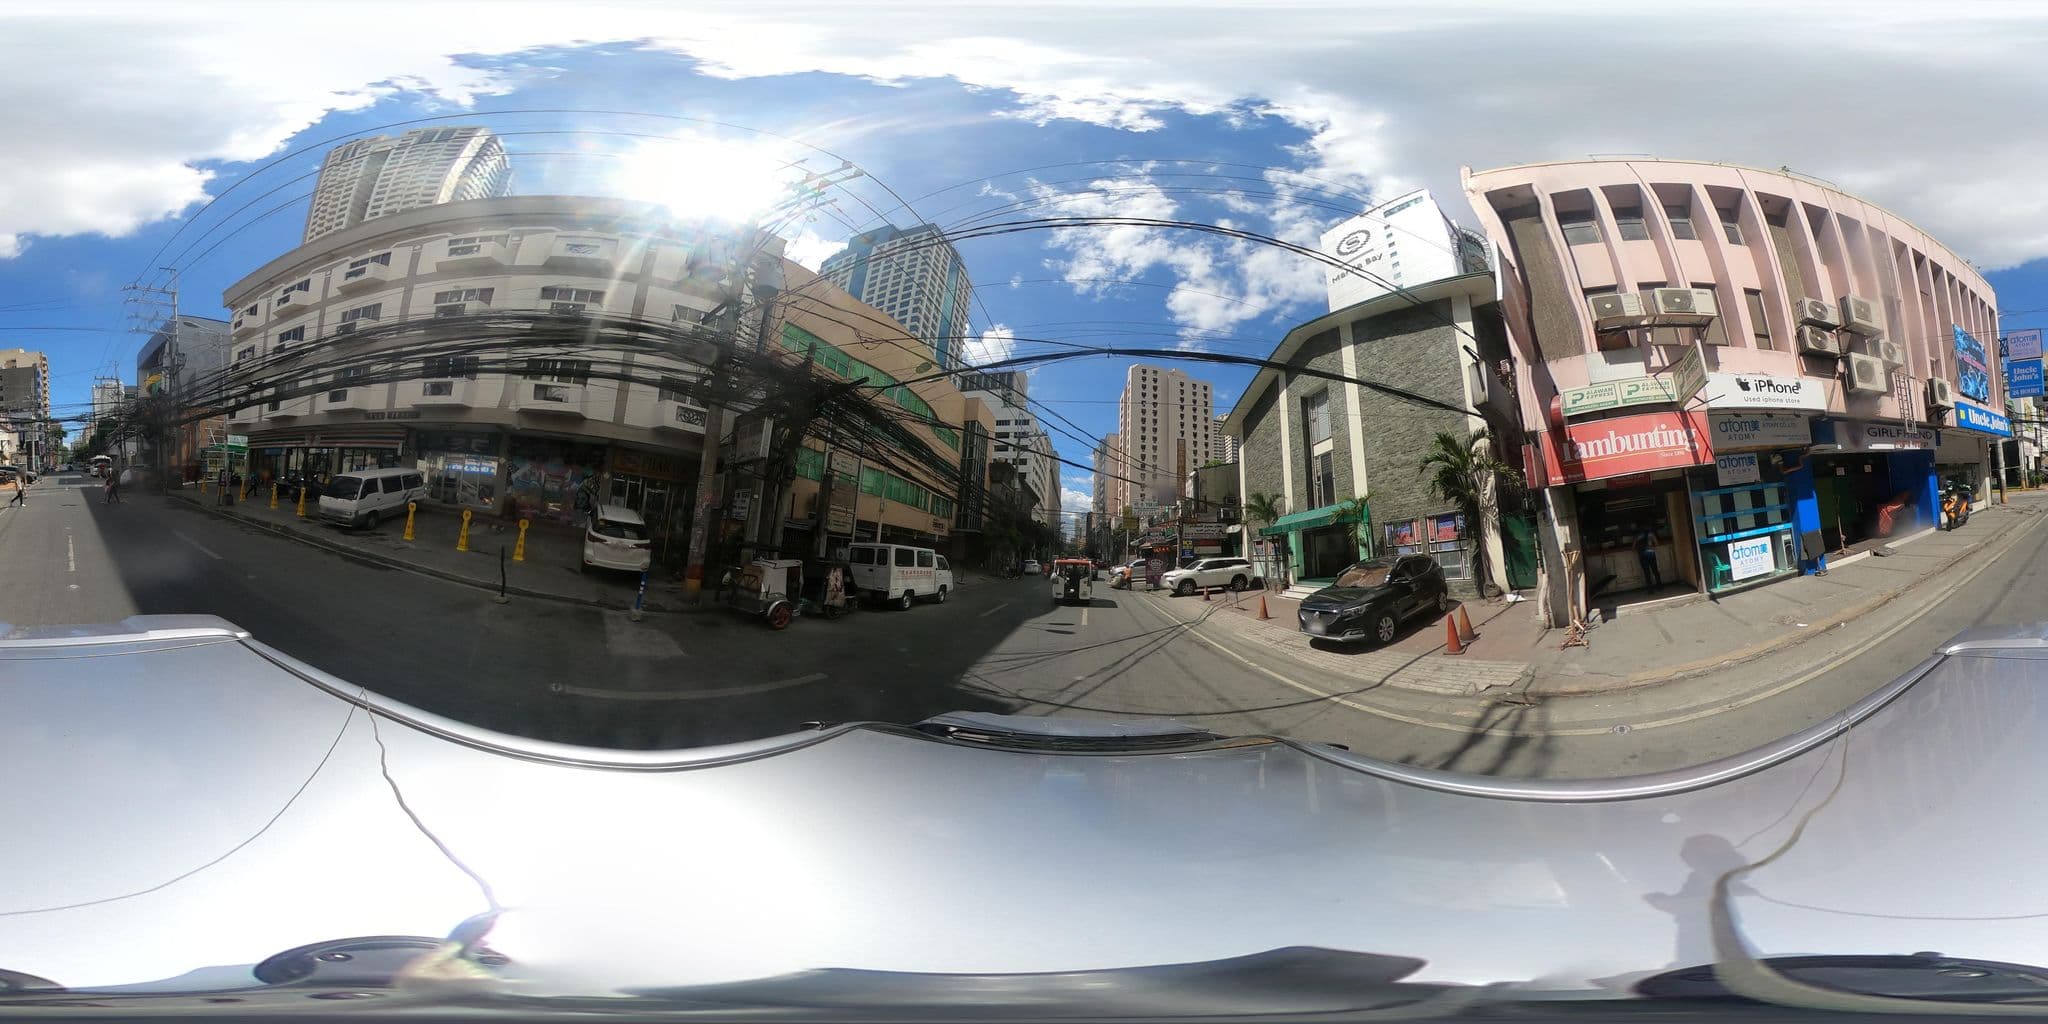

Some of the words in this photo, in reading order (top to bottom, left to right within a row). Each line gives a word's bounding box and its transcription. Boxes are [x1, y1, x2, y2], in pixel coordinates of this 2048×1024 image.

[1332, 263, 1363, 284] Mana
[1365, 252, 1383, 266] Bay
[2011, 371, 2040, 382] John's
[2013, 366, 2037, 376] Uncle
[1754, 379, 1800, 394] iPhone
[1586, 391, 1614, 400] EXPRESS
[1968, 408, 1990, 427] Uncle
[1990, 415, 2009, 432] John's
[1728, 433, 1755, 441] ATOMY
[1867, 427, 1933, 440] GIRLFRIEND
[1562, 424, 1698, 462] Tambunting
[1728, 467, 1752, 475] ATOMY
[1740, 556, 1764, 566] ATOMY
